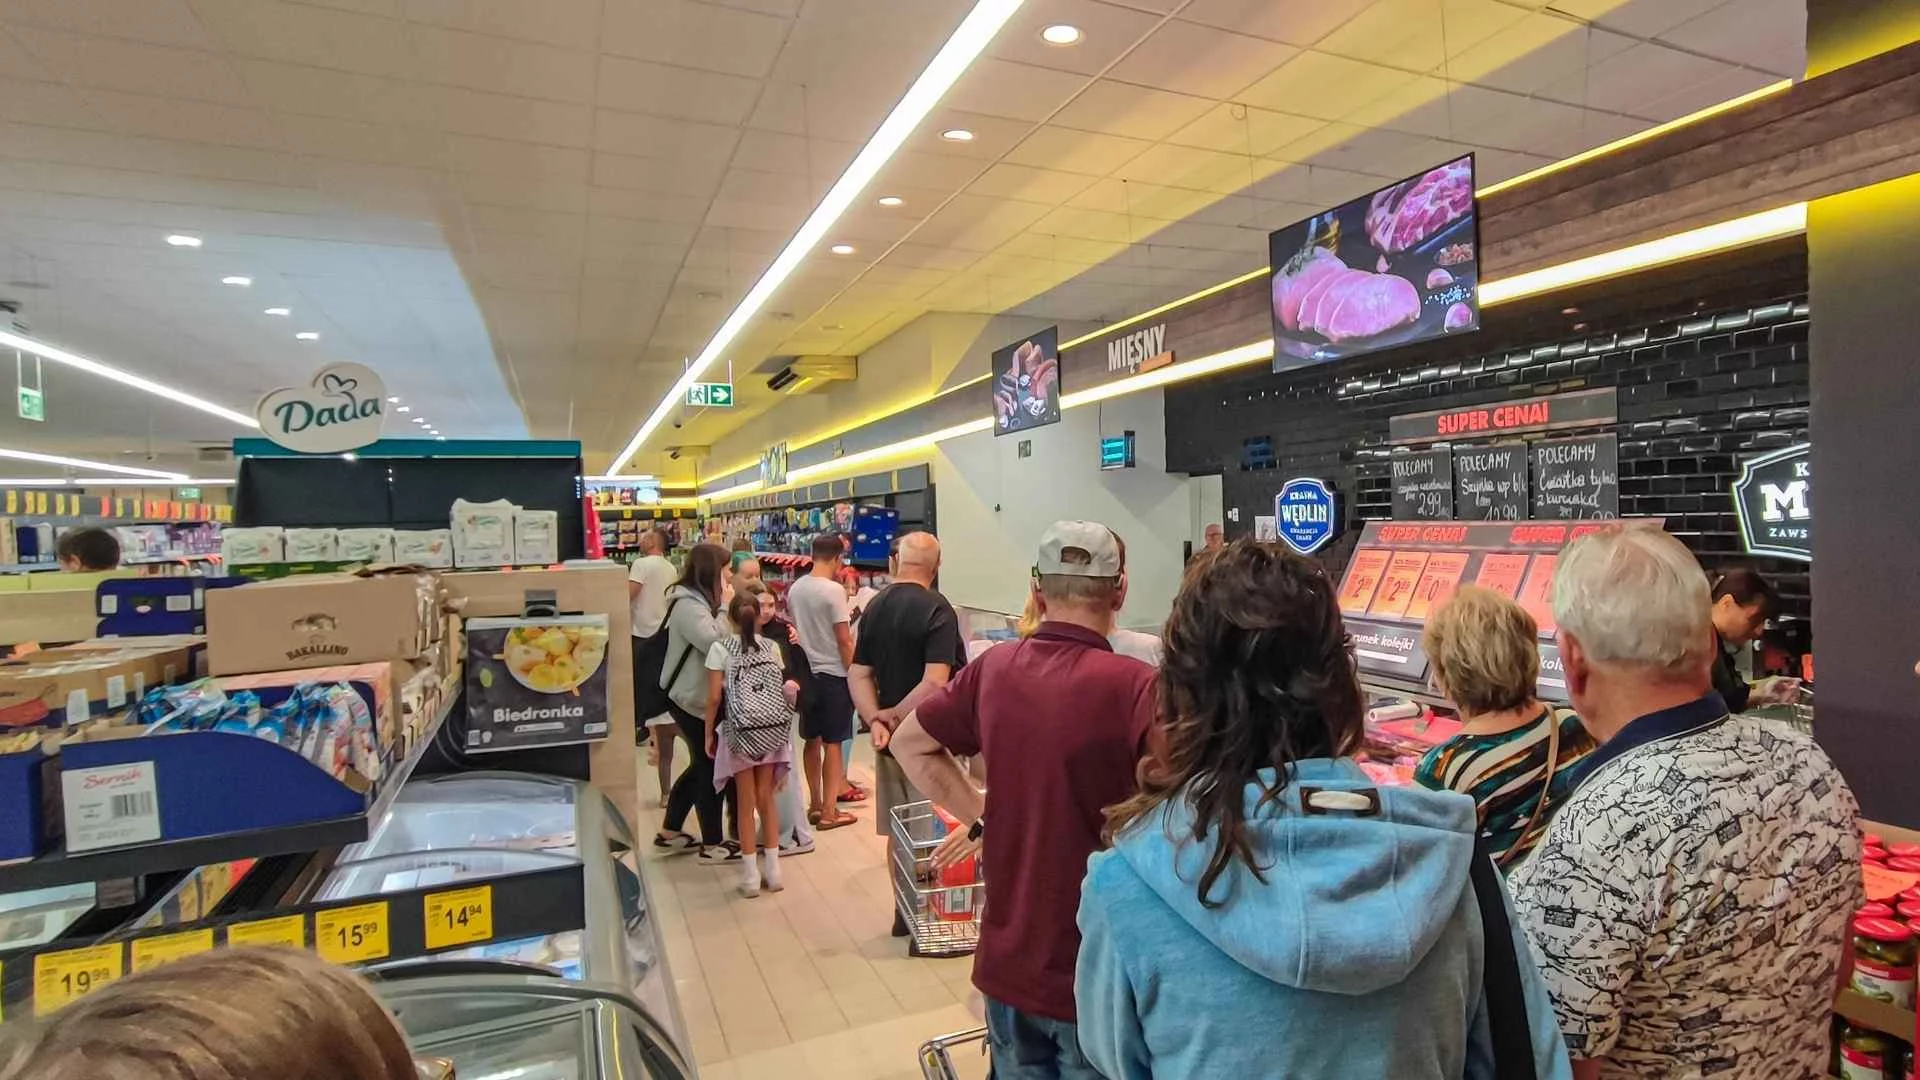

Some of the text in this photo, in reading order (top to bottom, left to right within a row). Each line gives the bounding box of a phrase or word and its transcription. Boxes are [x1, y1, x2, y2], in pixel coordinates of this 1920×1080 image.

[1108, 323, 1166, 375] MIĘSNY
[274, 391, 381, 434] Dada
[1438, 400, 1549, 434] SUPER CENA!
[1460, 451, 1511, 473] POLECAMY
[1538, 442, 1597, 465] POLECAMY
[1393, 457, 1434, 478] POLECAMY
[1281, 504, 1328, 527] WĘDLIN
[1378, 526, 1420, 543] SUPER
[1352, 634, 1380, 645] runek
[285, 644, 350, 661] BAKALLINO
[493, 704, 584, 723] Biedronka
